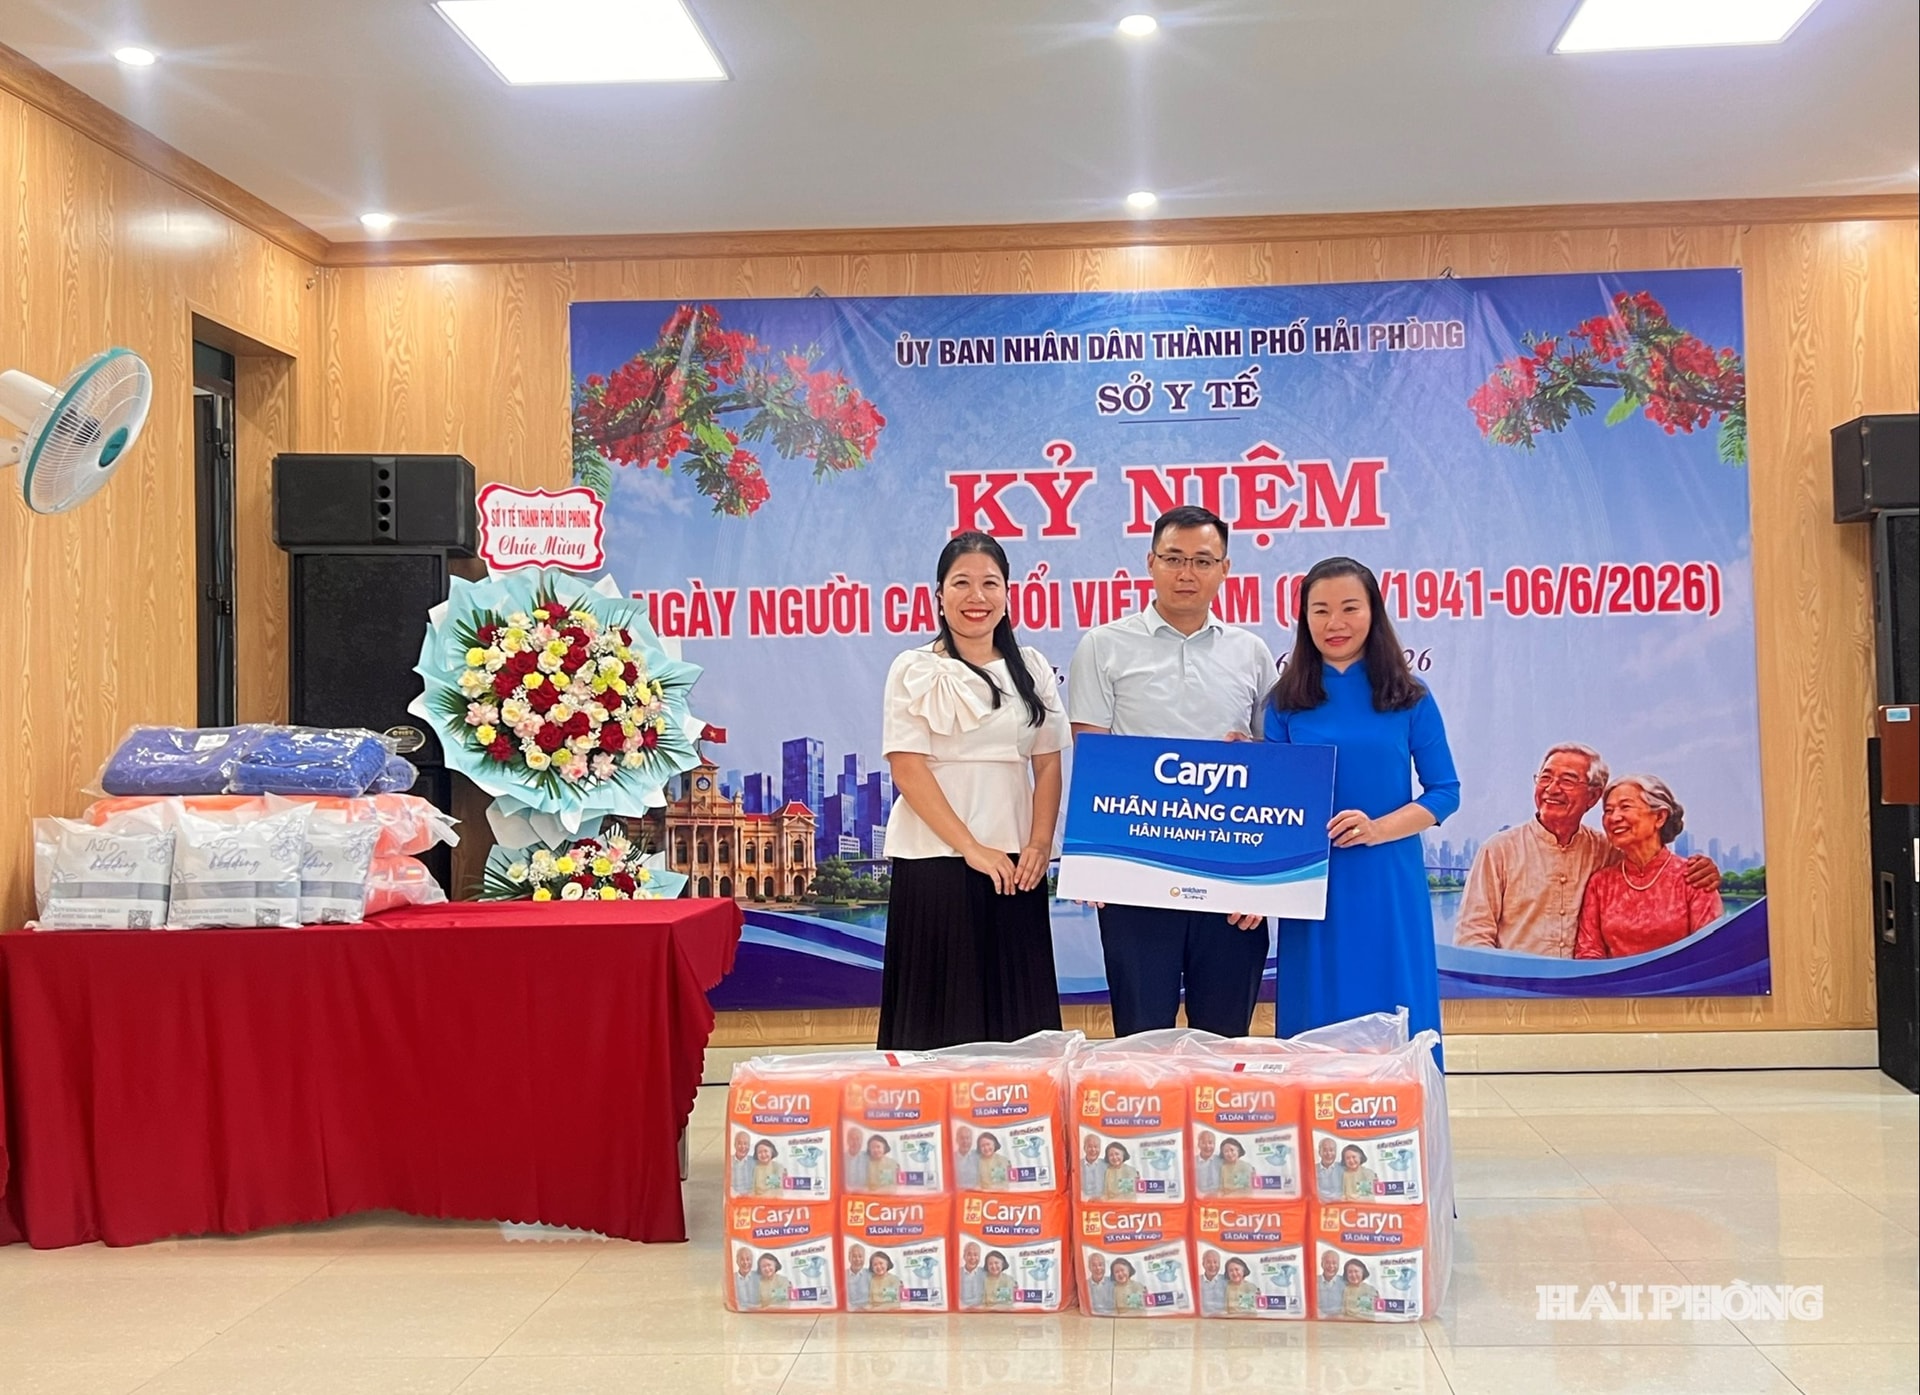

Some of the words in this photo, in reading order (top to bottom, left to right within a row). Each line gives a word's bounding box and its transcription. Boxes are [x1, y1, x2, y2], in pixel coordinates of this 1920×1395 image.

[897, 333, 931, 366] ỦY
[939, 338, 995, 364] BAN
[1004, 331, 1079, 363] NHÂN
[1088, 330, 1144, 360] DÂN
[1152, 325, 1242, 358] THÀNH
[1251, 319, 1308, 354] PHỐ
[1315, 319, 1359, 352] HẢI
[1370, 318, 1464, 350] PHÒNG
[1099, 373, 1151, 413] SỞ
[1164, 383, 1192, 410] Y
[1206, 366, 1260, 408] TẾ
[949, 444, 1093, 537] KỶ
[1125, 443, 1386, 546] NIỆM
[491, 501, 500, 527] SỞ
[502, 509, 506, 527] Y
[508, 502, 516, 527] TẾ
[517, 505, 539, 527] THÀNH
[541, 503, 554, 528] PHỐ
[556, 502, 566, 528] HẢI
[568, 505, 590, 528] PHÒNG
[499, 535, 537, 555] Chúc
[540, 536, 586, 560] Mừng
[750, 575, 870, 635] NGƯỜI
[884, 586, 936, 632] CA
[1154, 753, 1248, 794] Caryn
[1093, 795, 1156, 817] NHÃN
[1162, 798, 1226, 821] HÀNG
[1230, 805, 1304, 826] CARYN
[1129, 823, 1161, 838] HÂN
[1163, 828, 1206, 842] HẠNH
[1209, 829, 1231, 844] TÀI
[1233, 832, 1264, 847] TRỢ
[752, 1091, 810, 1115] Caryn
[864, 1084, 920, 1110] Caryn
[971, 1082, 1028, 1107] Caryn
[1101, 1091, 1161, 1117] Caryn
[1215, 1088, 1275, 1113] Caryn
[1335, 1093, 1397, 1119] Caryn
[752, 1206, 810, 1227] Caryn
[866, 1202, 924, 1226] Caryn
[983, 1200, 1041, 1226] Caryn
[1101, 1211, 1161, 1233] Caryn
[1221, 1210, 1281, 1233] Caryn
[1341, 1208, 1402, 1234] Caryn
